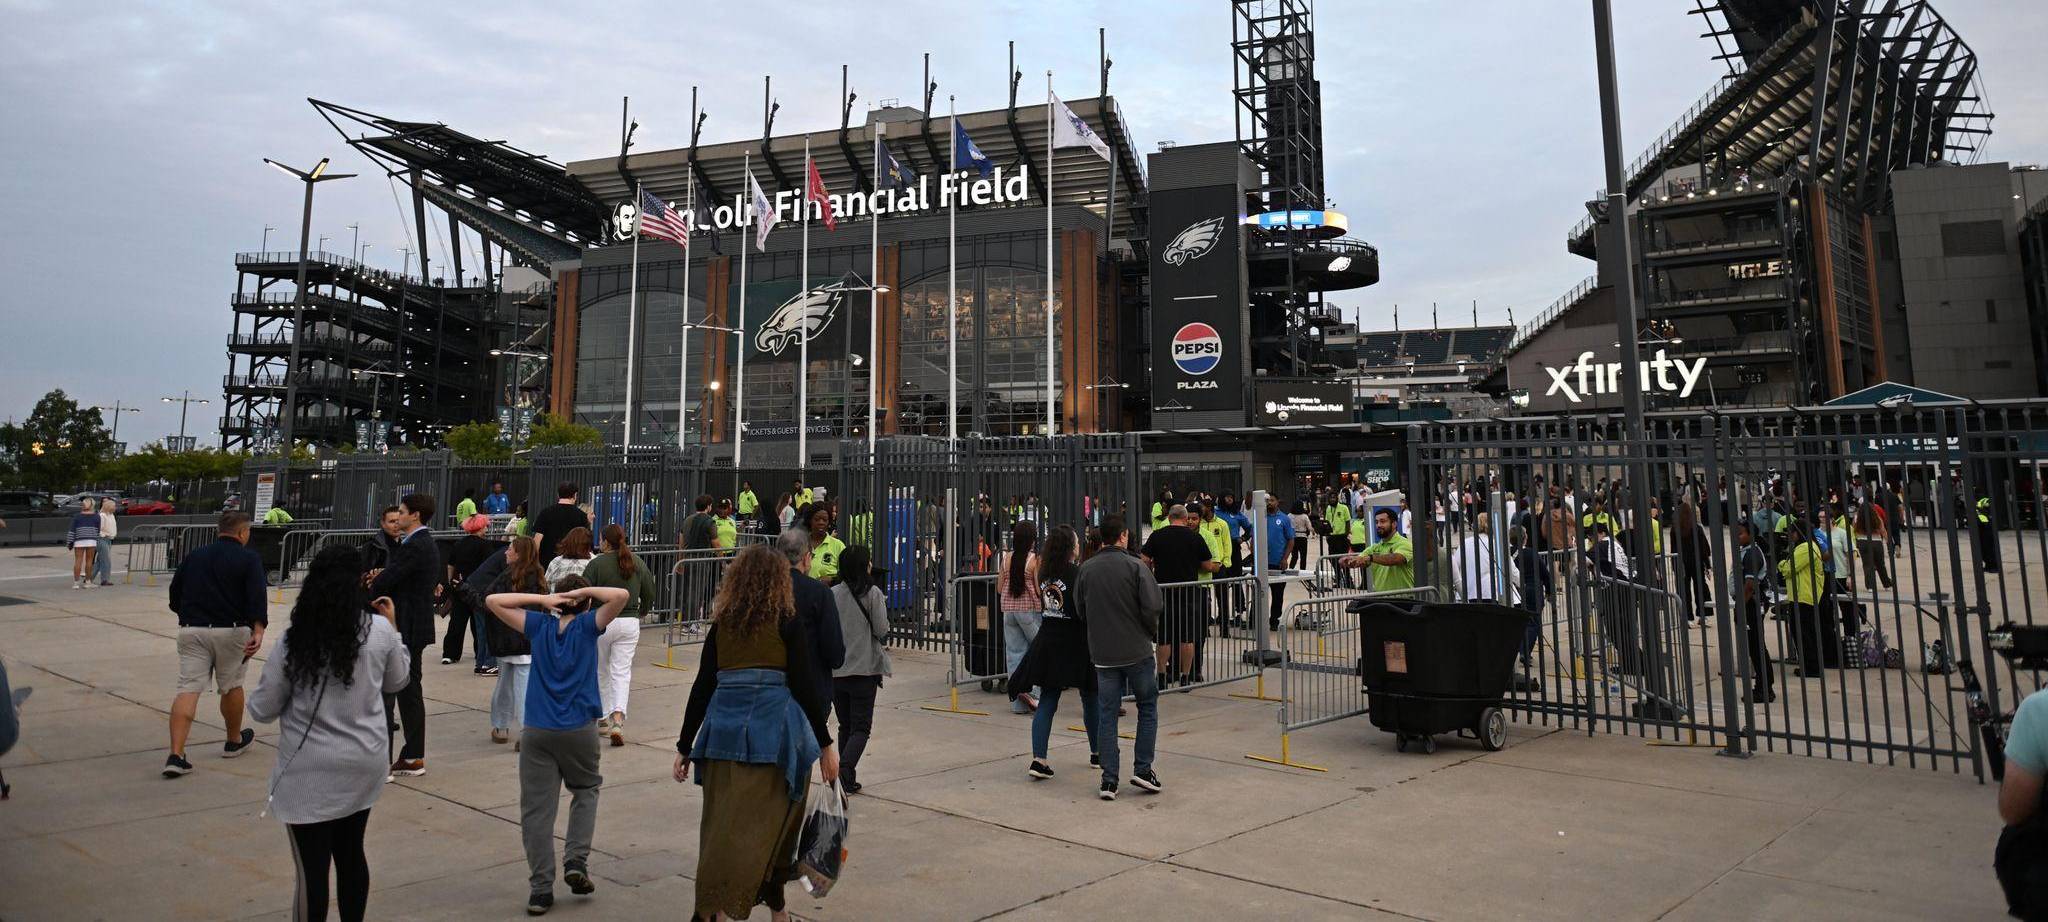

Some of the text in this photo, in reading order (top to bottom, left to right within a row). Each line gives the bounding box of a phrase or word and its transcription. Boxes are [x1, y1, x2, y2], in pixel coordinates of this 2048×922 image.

[776, 174, 929, 223] Financial
[941, 164, 1027, 208] Field
[1727, 260, 1792, 279] AGLE
[1175, 342, 1219, 355] PEPSI
[1177, 380, 1218, 389] PLAZA
[777, 427, 798, 435] GUEST
[799, 425, 831, 434] RVICES
[1374, 469, 1390, 477] PRO
